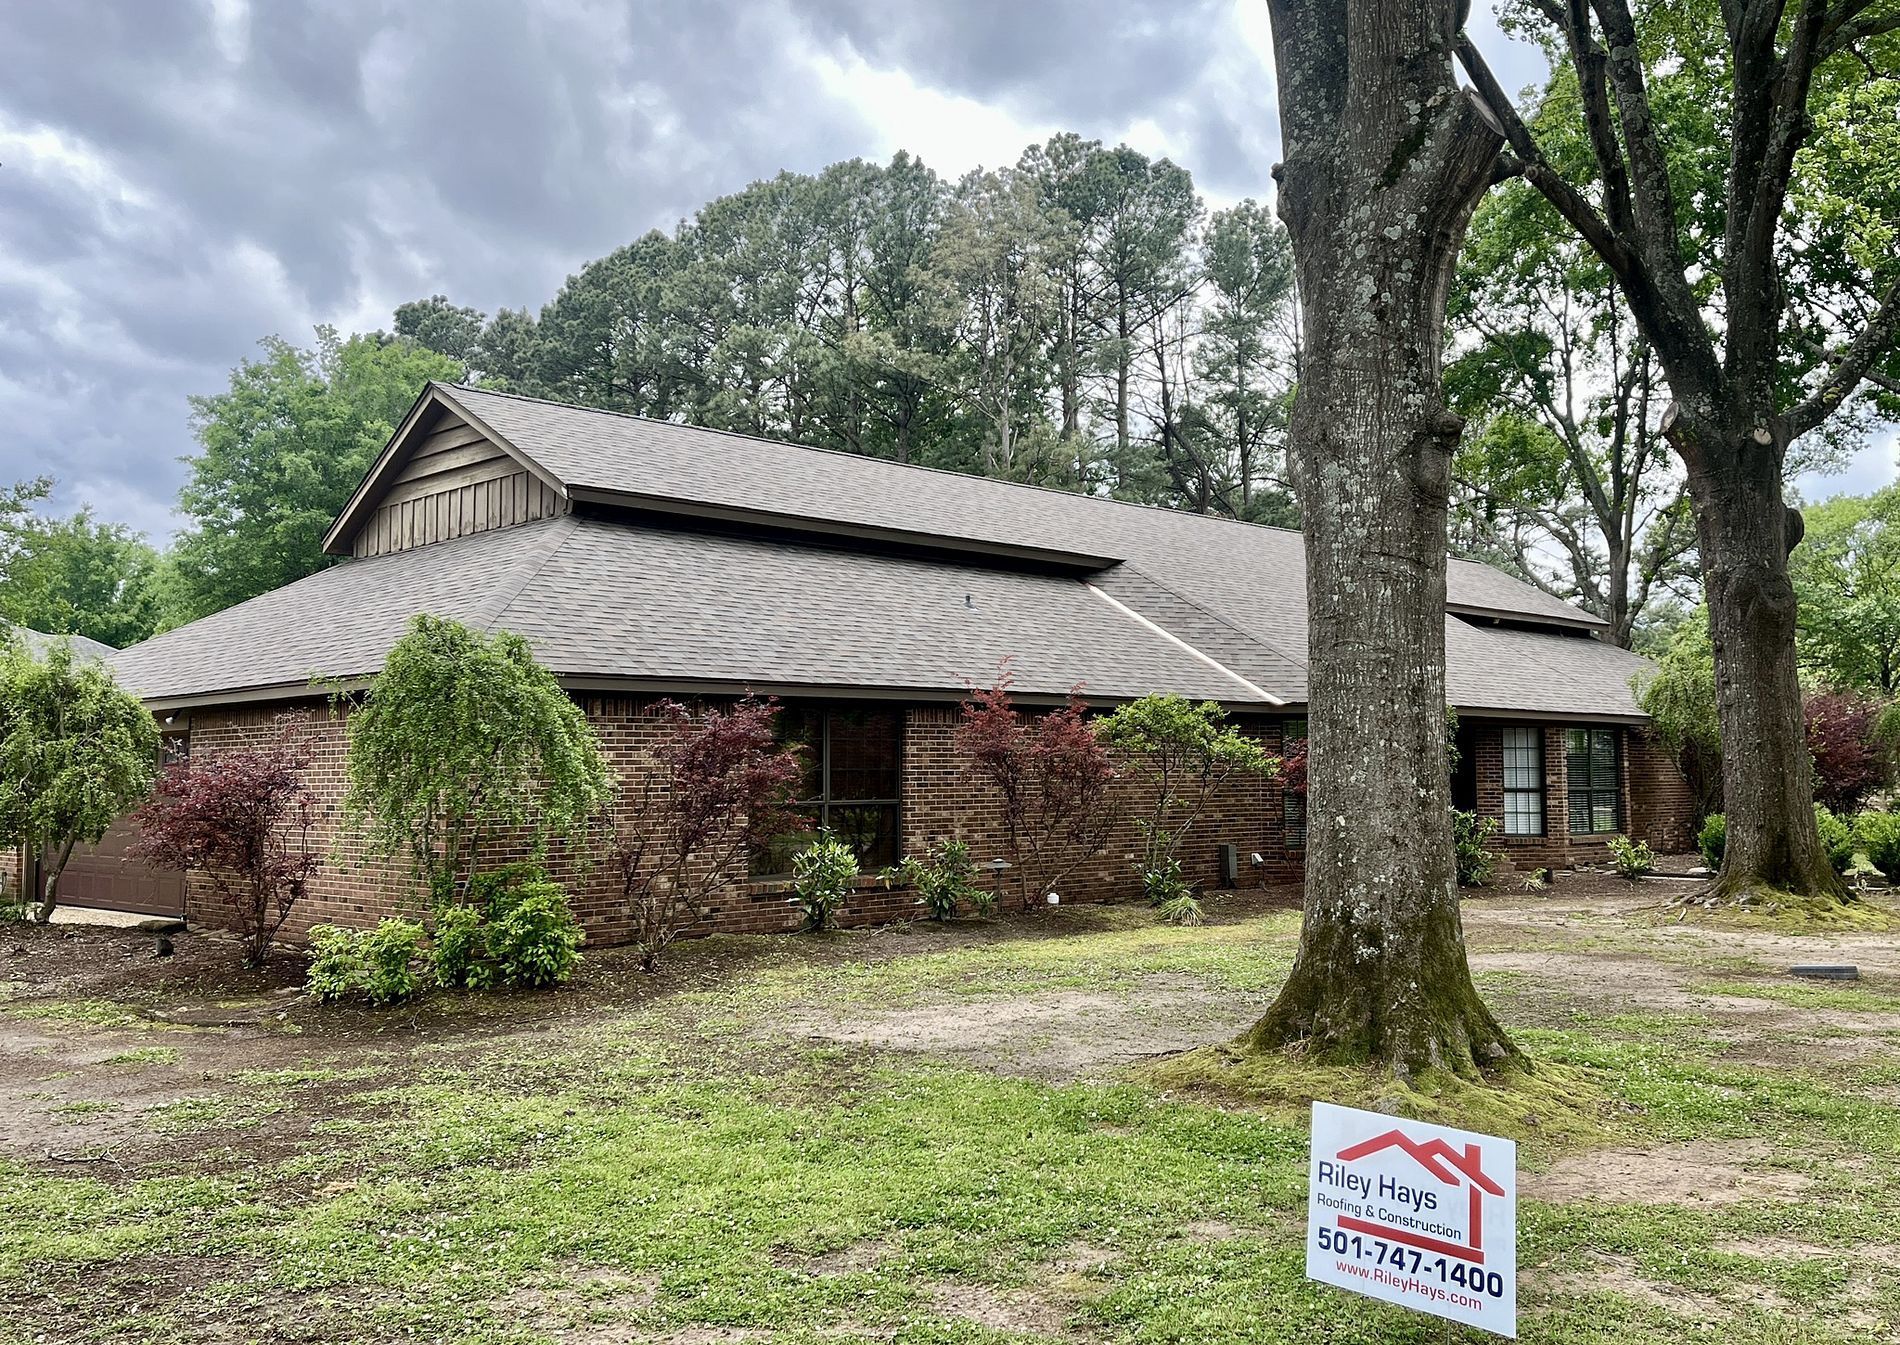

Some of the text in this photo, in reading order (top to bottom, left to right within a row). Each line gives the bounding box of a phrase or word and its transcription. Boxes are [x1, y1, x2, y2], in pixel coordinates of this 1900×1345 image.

[1318, 1160, 1438, 1212] Riley Hays
[1317, 1193, 1462, 1240] Roofing & Construction
[1318, 1226, 1504, 1298] 501-747-1400
[1336, 1260, 1482, 1311] www.RileyHays.com
